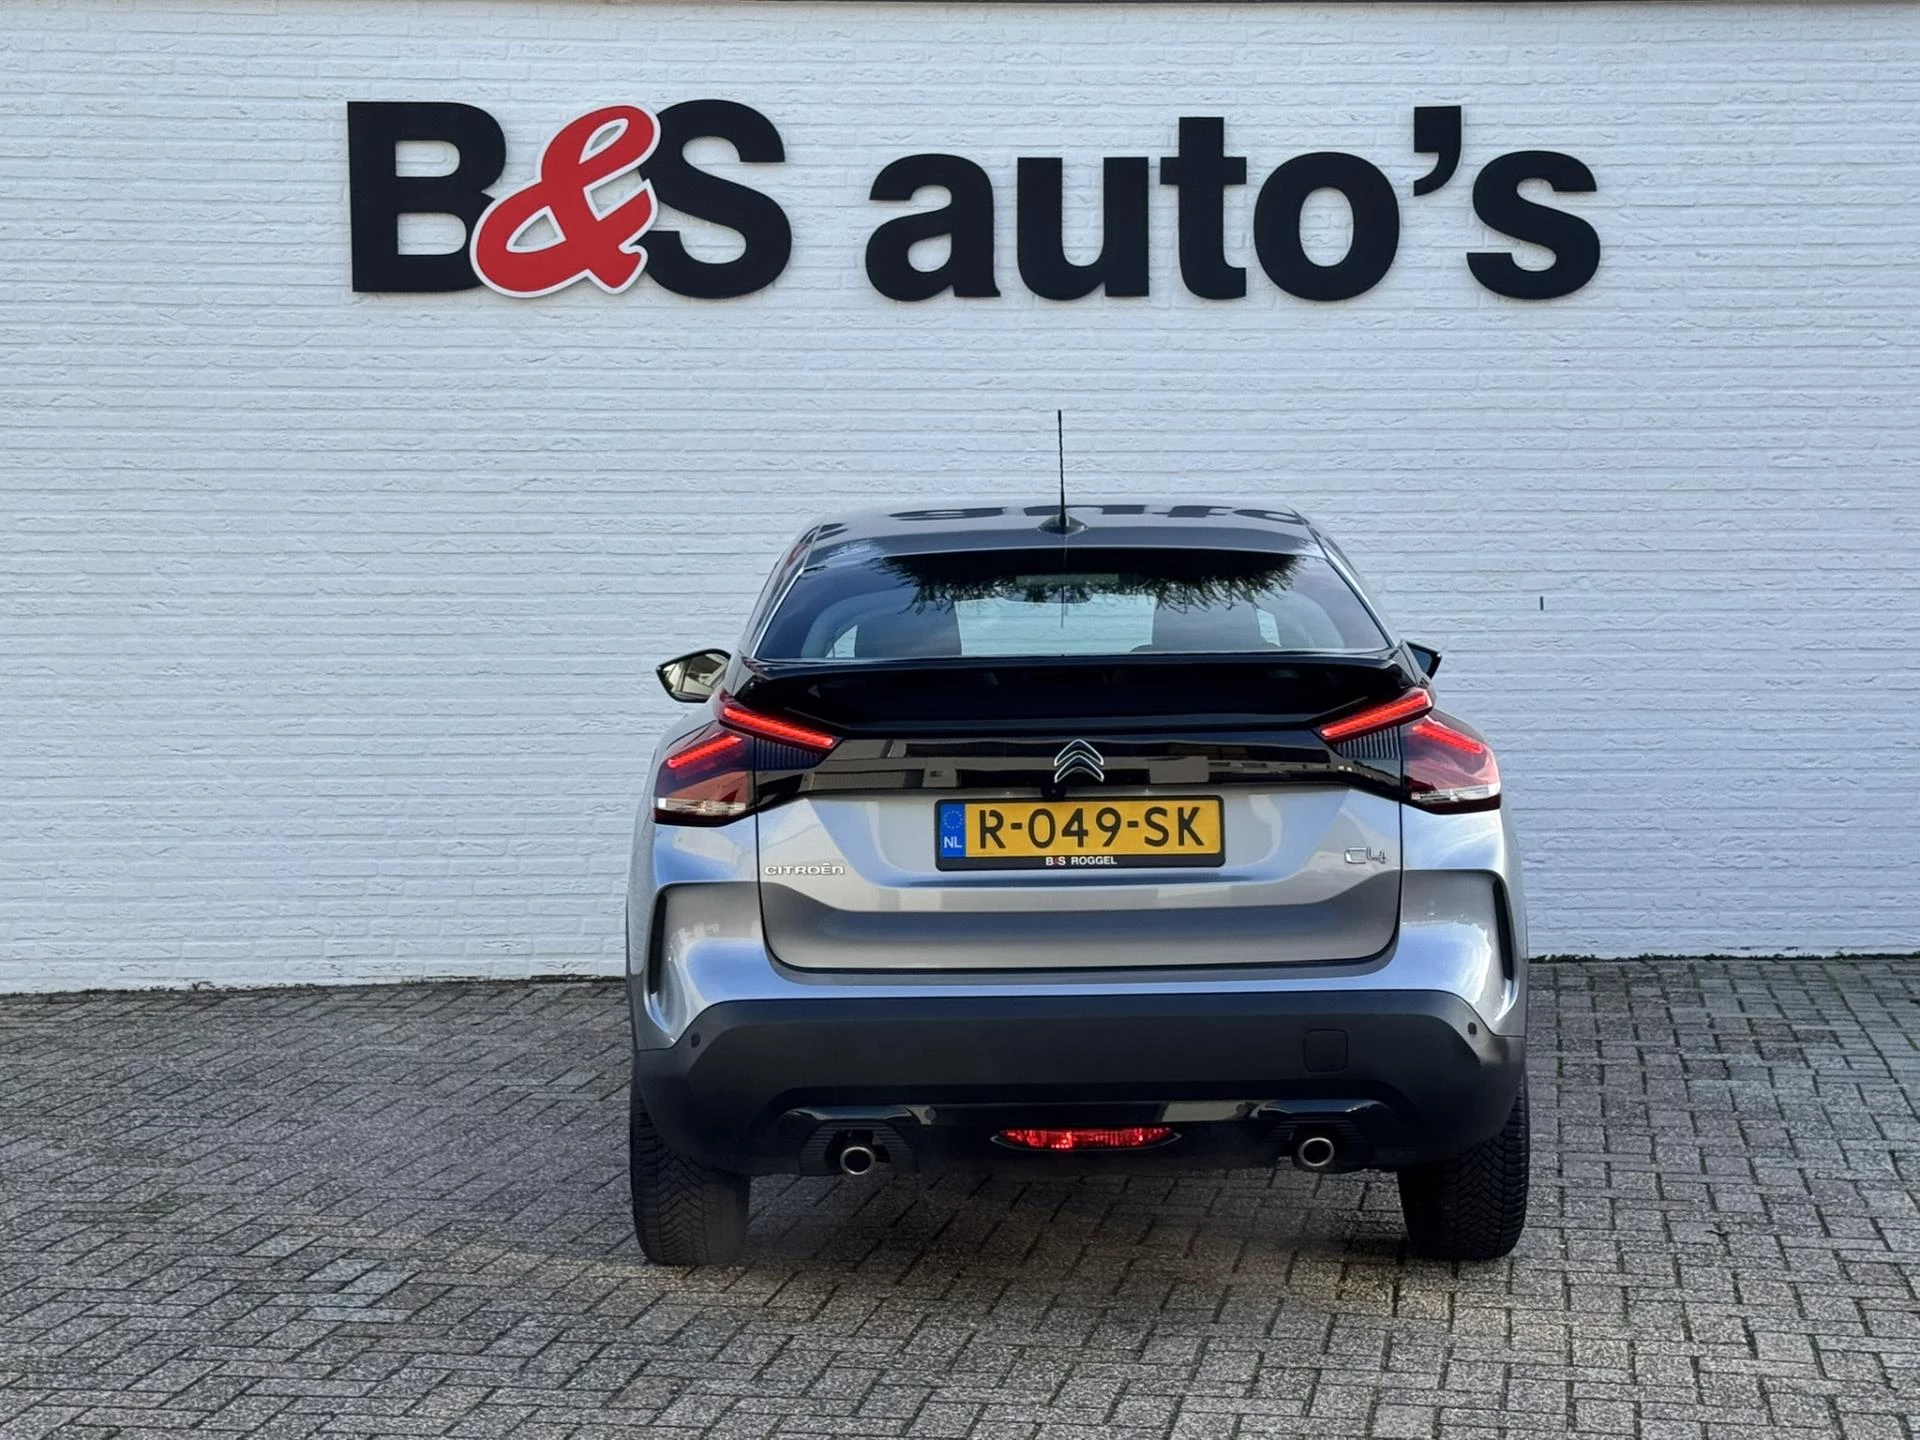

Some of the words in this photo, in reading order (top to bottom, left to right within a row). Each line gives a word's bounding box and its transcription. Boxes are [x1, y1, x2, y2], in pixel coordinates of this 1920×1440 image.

[347, 99, 793, 299] B&S
[866, 105, 1601, 302] auto's
[978, 806, 1205, 849] R-049-SK
[943, 835, 963, 849] NL
[1071, 855, 1118, 866] ROGGEL
[1344, 847, 1389, 864] C4
